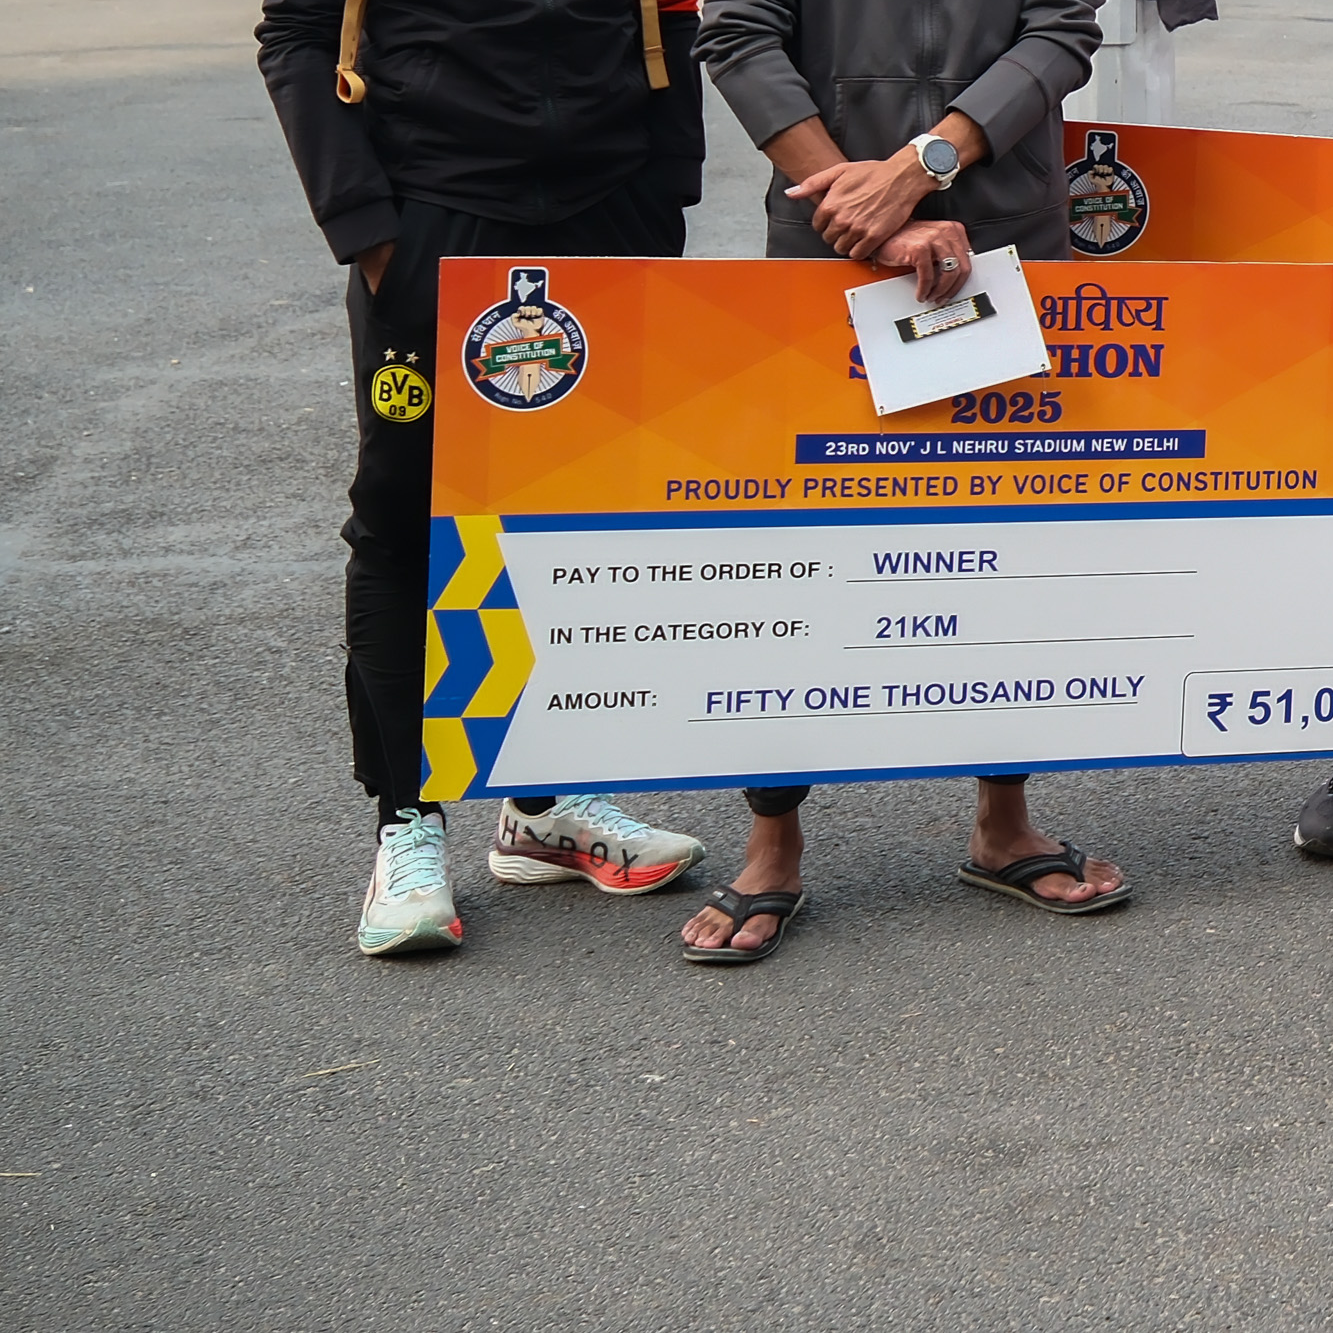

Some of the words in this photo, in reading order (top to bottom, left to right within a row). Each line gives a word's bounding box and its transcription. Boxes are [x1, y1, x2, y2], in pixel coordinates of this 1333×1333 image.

[1039, 283, 1169, 331] भविष्य
[495, 349, 556, 363] CONSTITUTION
[506, 343, 531, 353] VOICE
[533, 341, 544, 349] OF
[379, 372, 424, 407] BVB
[389, 405, 406, 416] 09
[948, 391, 1062, 424] 2025
[826, 442, 869, 455] 23RD
[921, 441, 930, 454] J
[937, 441, 946, 454] L
[953, 441, 1008, 453] NEHRU
[1015, 439, 1084, 453] STADIUM
[1092, 439, 1127, 451] NEW
[1133, 438, 1178, 451] DELHI
[667, 479, 792, 500] PROUDLY
[804, 476, 958, 498] PRESENTED
[970, 476, 1002, 495] BY
[1013, 474, 1088, 494] VOICE
[1100, 473, 1131, 493] OF
[1142, 470, 1316, 492] CONSTITUTION
[553, 567, 600, 584] PAY
[608, 566, 639, 582] TO
[647, 565, 692, 581] THE
[701, 563, 782, 580] ORDER
[790, 562, 820, 578] OF
[873, 551, 997, 574] WINNER
[551, 628, 572, 644] IN
[580, 626, 626, 643] THE
[635, 622, 765, 641] CATEGORY
[773, 621, 809, 637] OF:
[876, 615, 957, 638] 21KM
[547, 691, 656, 710] AMOUNT:
[707, 689, 795, 713] FIFTY
[805, 686, 870, 710] ONE
[882, 680, 1054, 706] THOUSAND
[1066, 676, 1145, 699] ONLY
